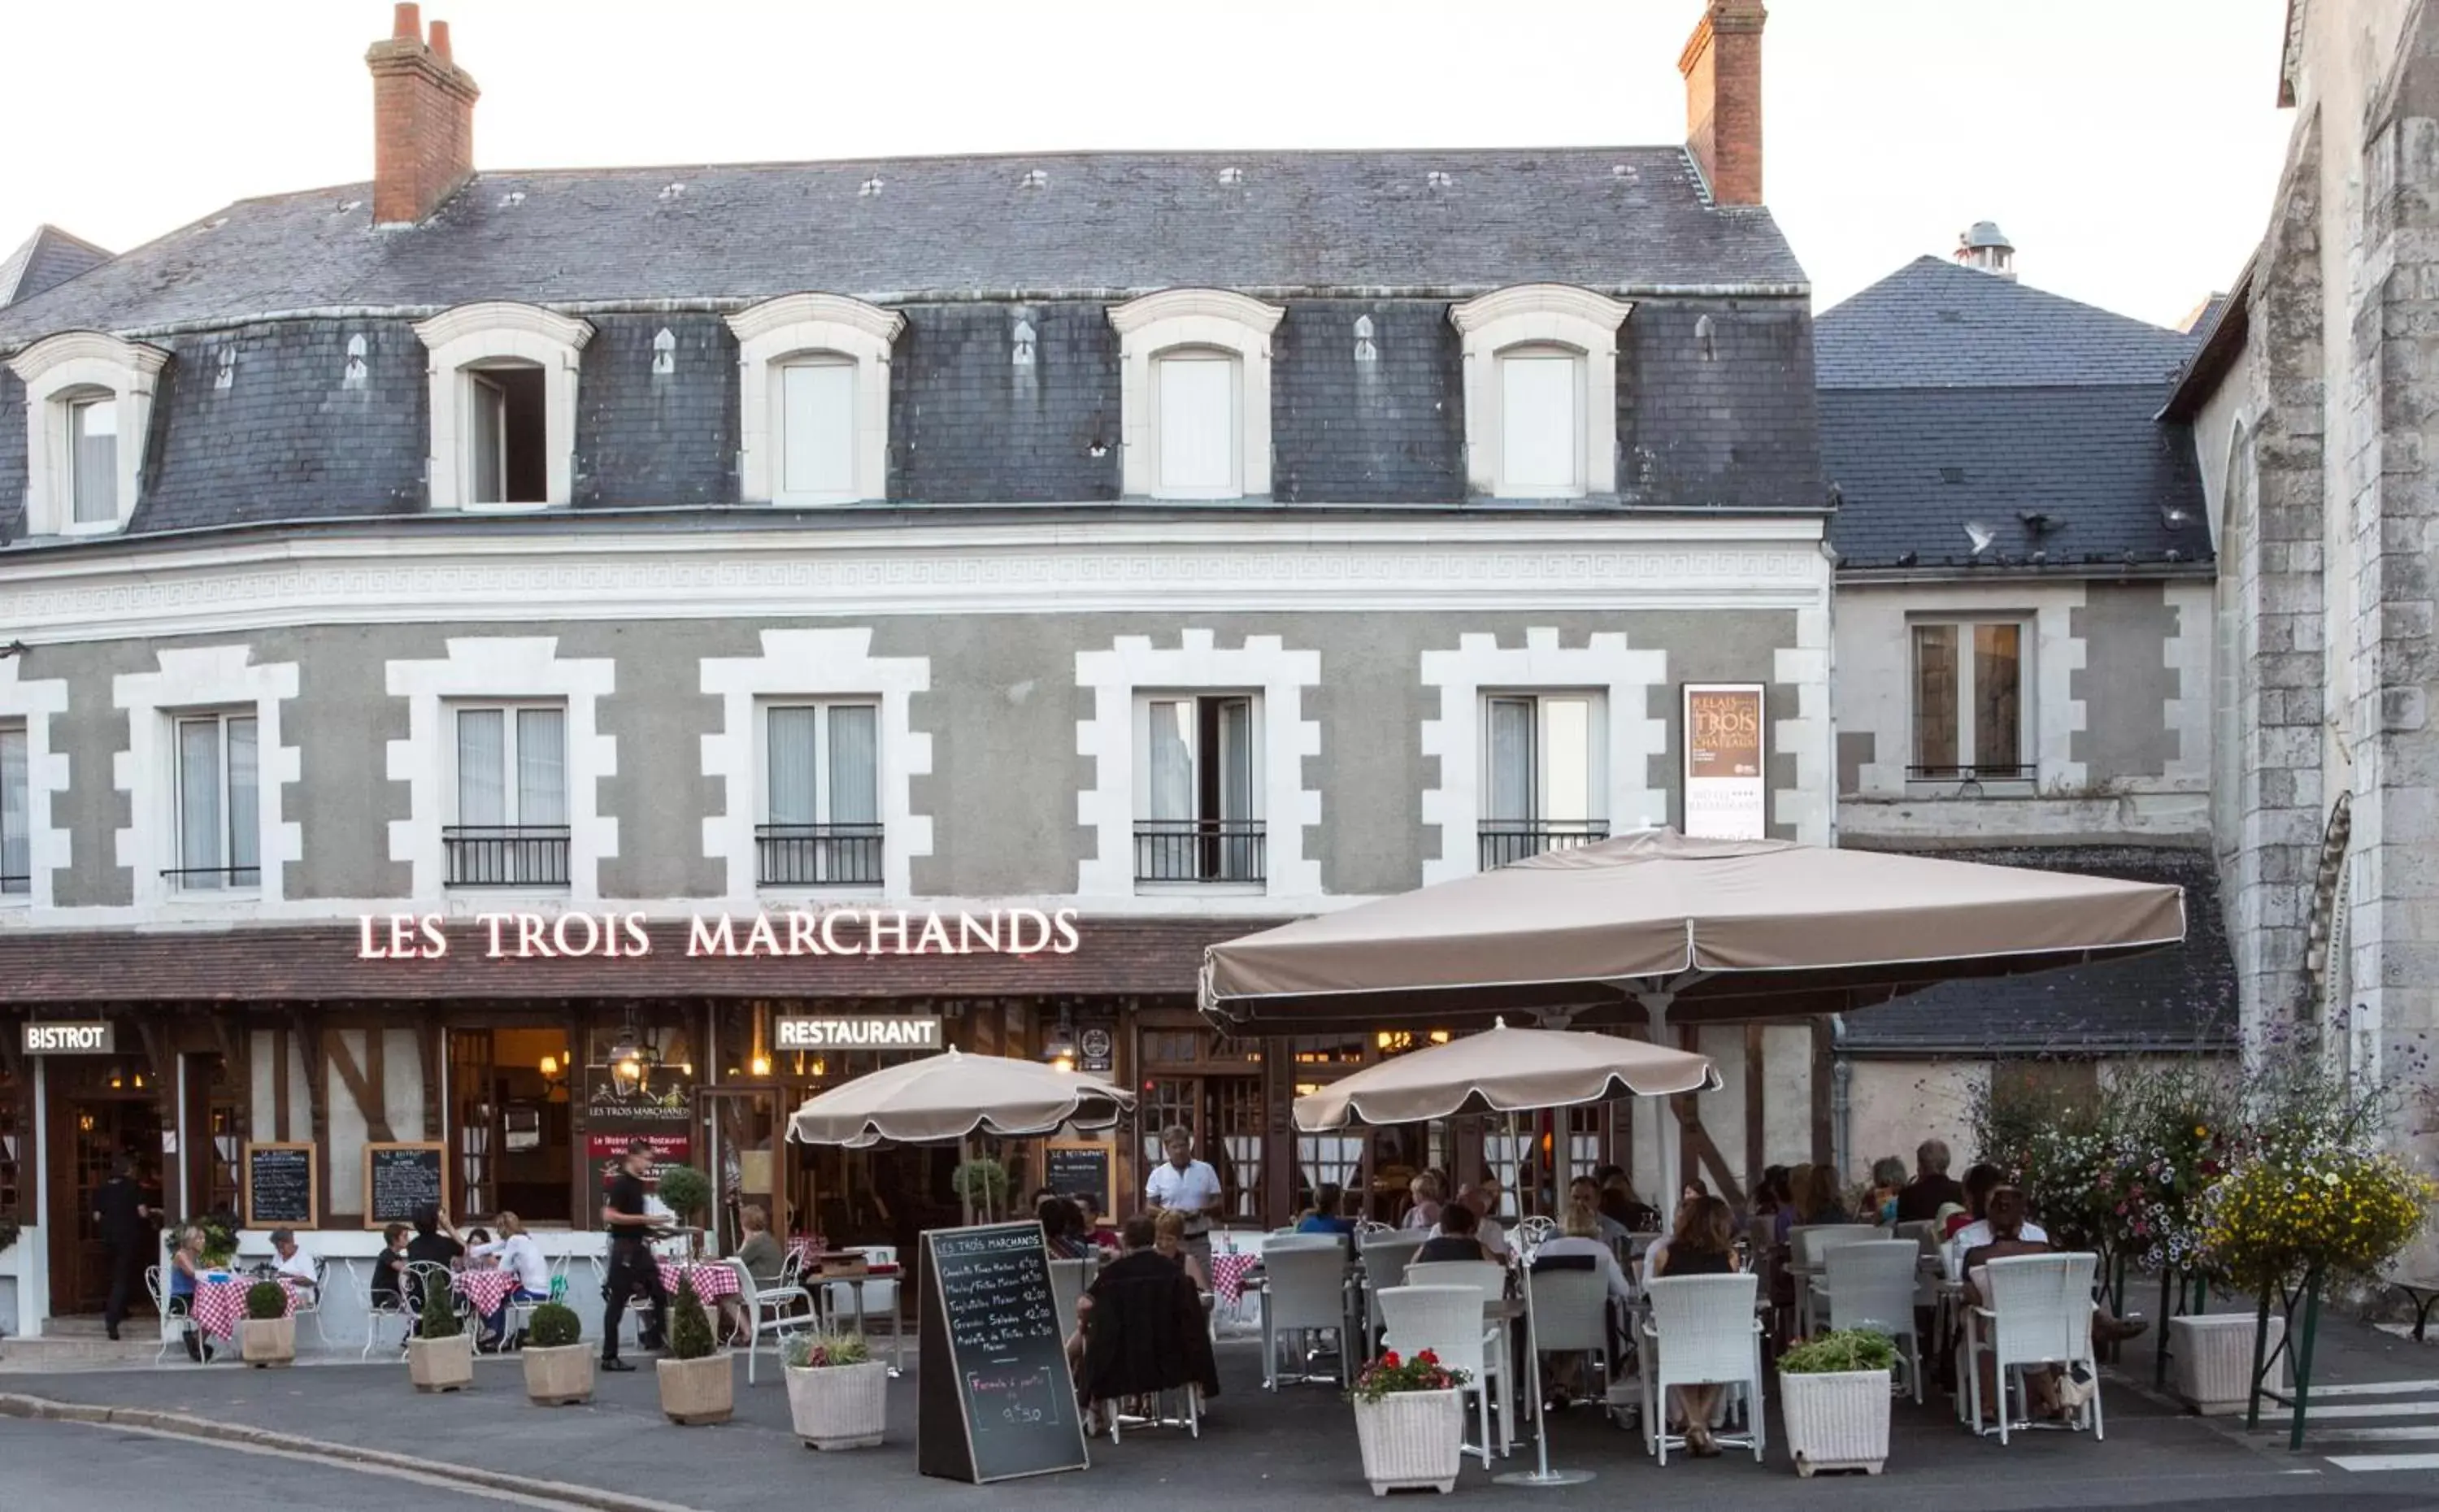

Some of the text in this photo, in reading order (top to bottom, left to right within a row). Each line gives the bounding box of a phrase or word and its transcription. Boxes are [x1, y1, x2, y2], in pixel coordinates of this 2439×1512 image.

[1696, 711, 1755, 732] TROIS
[358, 907, 1080, 959] LES TROIS MARCHANDS
[28, 1027, 105, 1049] BISTROT
[780, 1020, 935, 1044] RESTAURANT
[589, 1106, 689, 1117] LES TROIS MARCHANDS
[987, 1234, 1040, 1249] MARCHANDS
